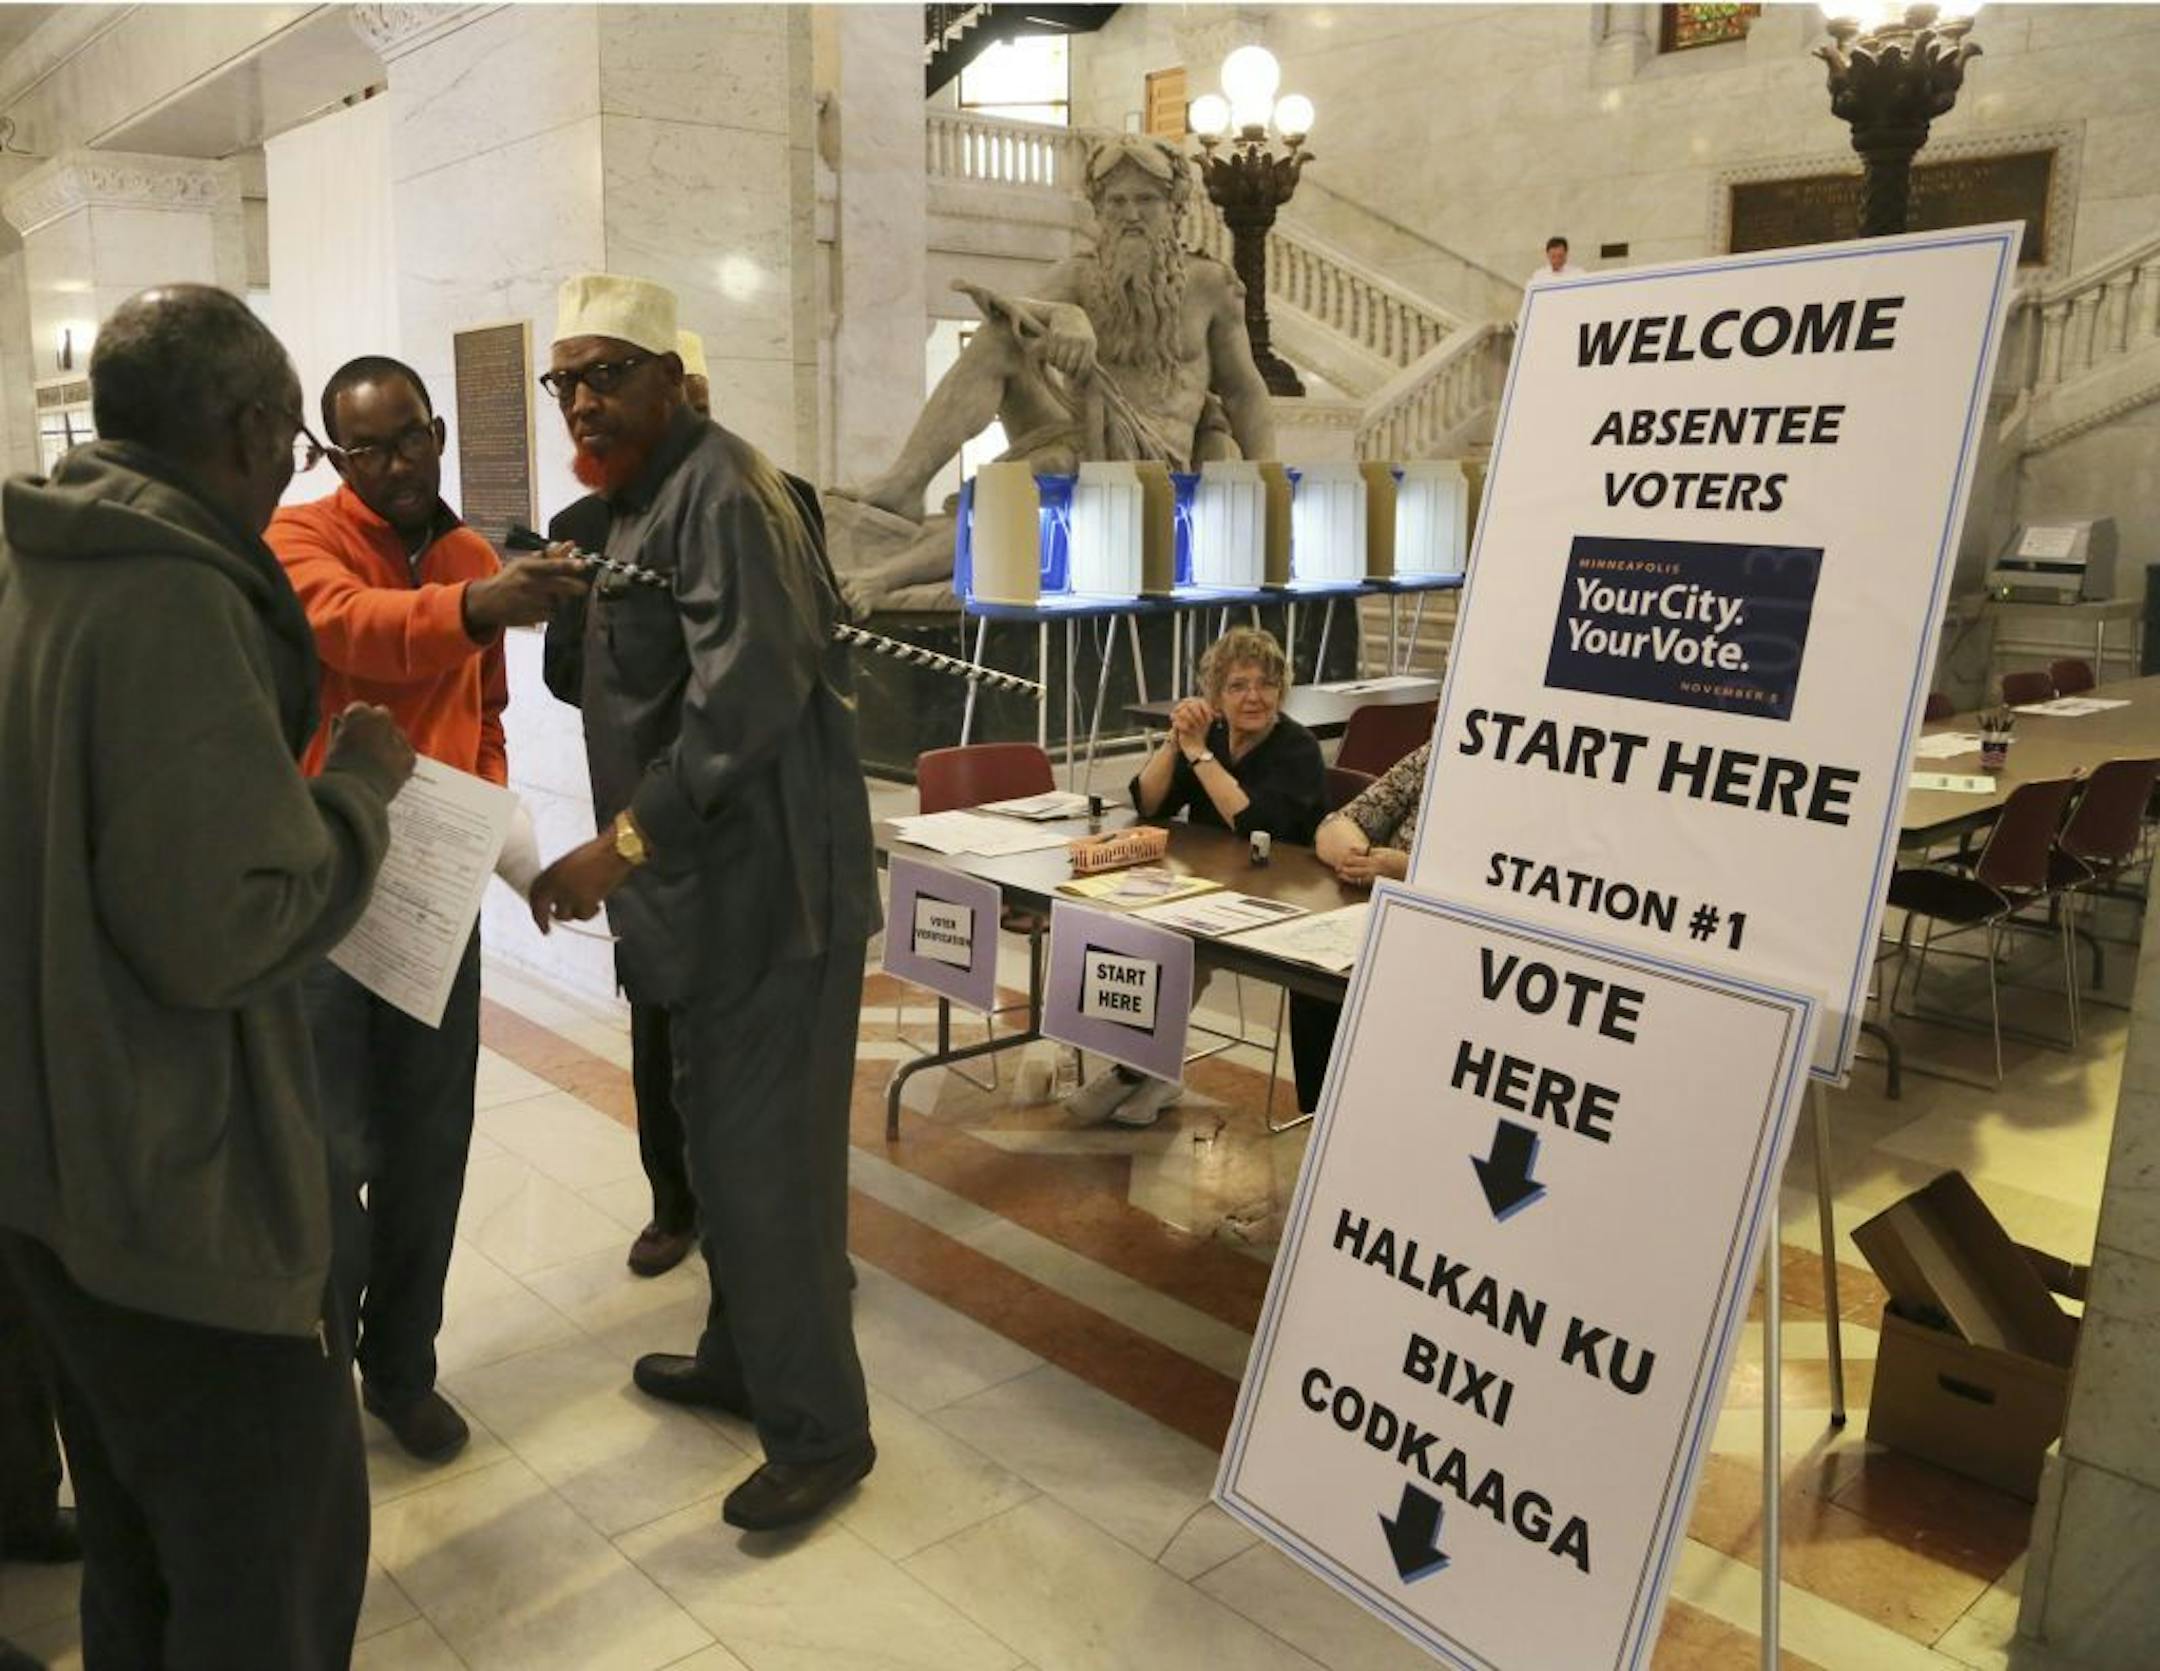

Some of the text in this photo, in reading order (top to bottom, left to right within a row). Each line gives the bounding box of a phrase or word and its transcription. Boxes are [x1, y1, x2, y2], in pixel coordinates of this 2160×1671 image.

[1578, 296, 1904, 367] WELCOME
[1591, 405, 1845, 446] ABSENTEE
[1605, 472, 1788, 512] VOTERS
[1578, 557, 1682, 575] MINNEAPOLIS
[1680, 681, 1764, 701] NOVEMBER
[1459, 708, 1861, 827] START HERE
[1486, 852, 1748, 951] STATION #1
[1096, 963, 1147, 987] START
[1098, 989, 1142, 1014] HERE
[1480, 947, 1646, 1044] VOTE
[1451, 1039, 1622, 1144] HERE
[1332, 1208, 1657, 1396] HALKAN KU
[1402, 1332, 1515, 1428] BIXI
[1301, 1366, 1591, 1575] CODKAAGA
